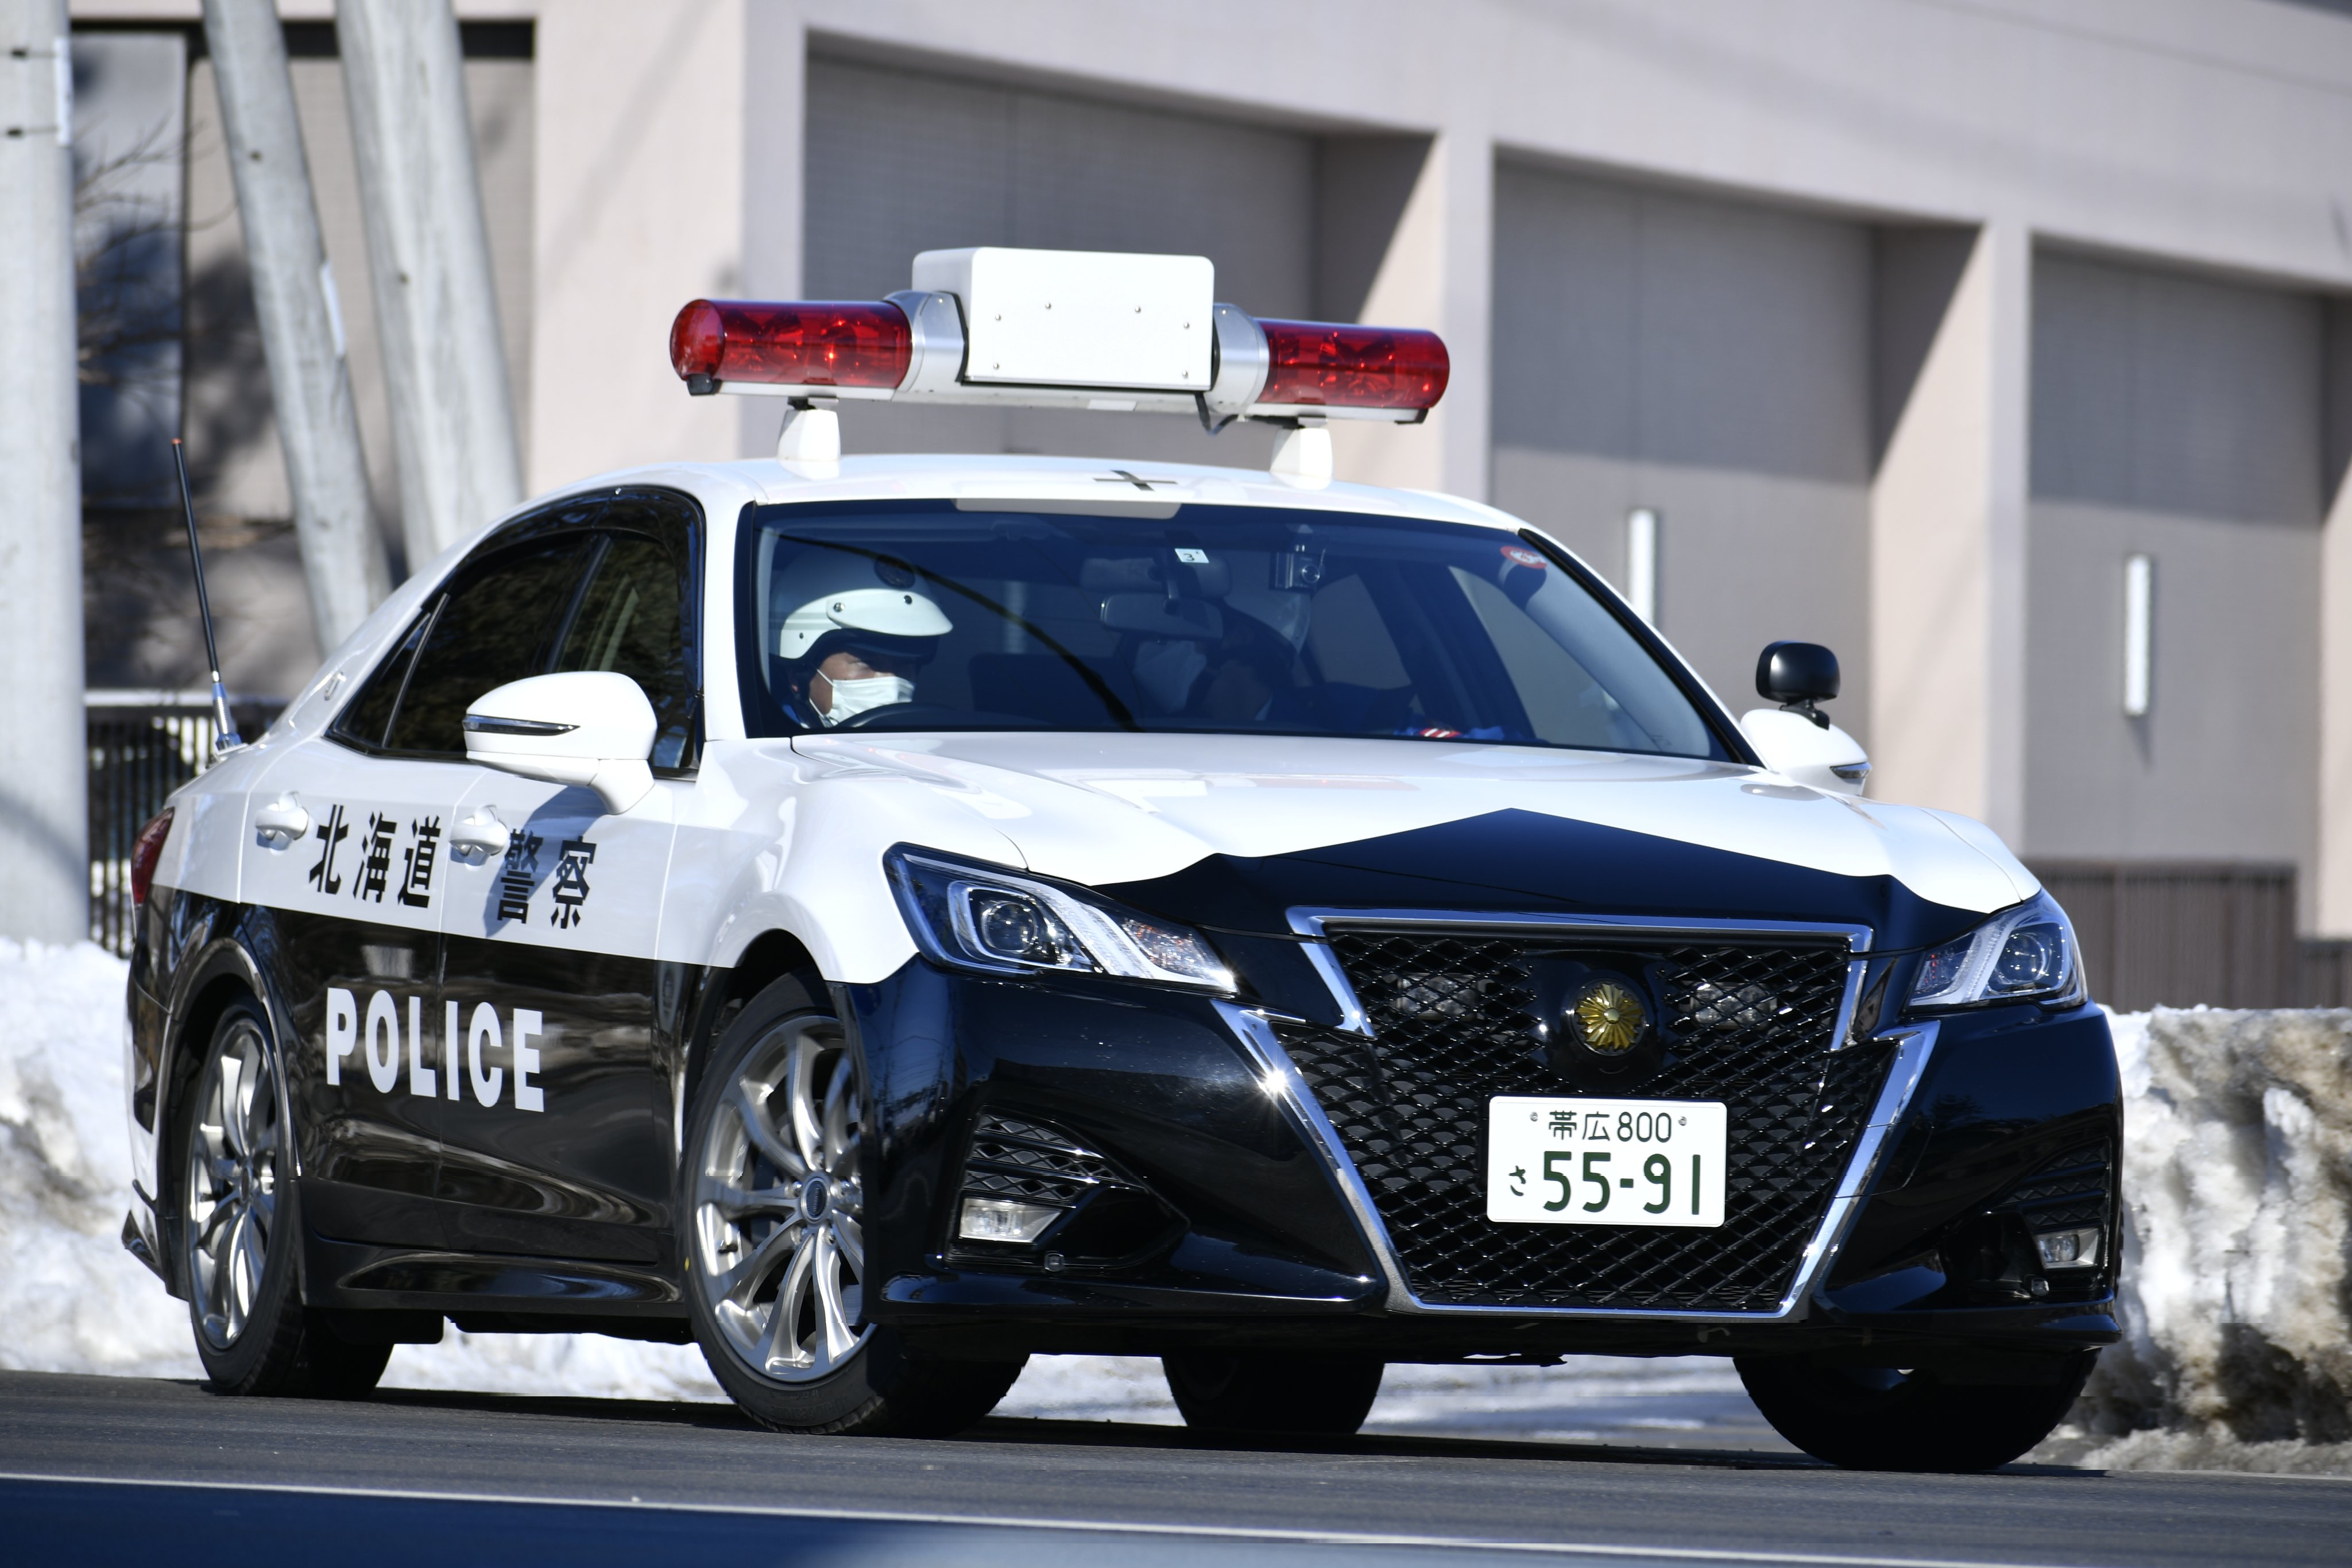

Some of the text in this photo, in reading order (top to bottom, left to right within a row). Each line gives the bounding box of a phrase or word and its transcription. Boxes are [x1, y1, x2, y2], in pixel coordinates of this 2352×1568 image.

[326, 987, 544, 1112] POLICE
[1508, 1150, 1701, 1215] さ 55-91
